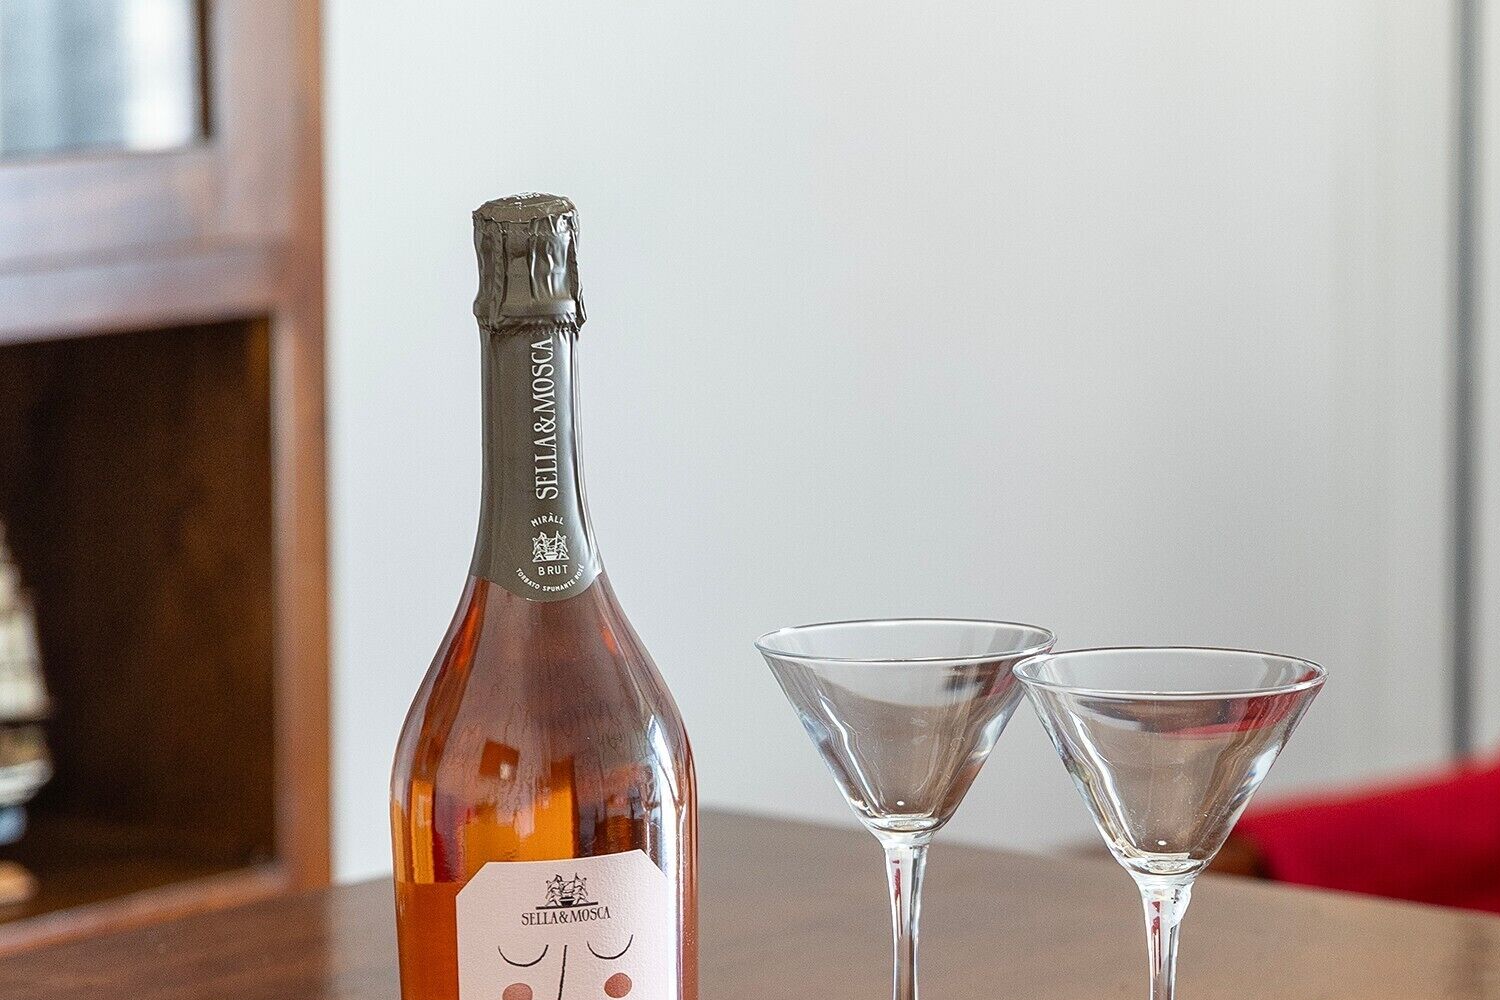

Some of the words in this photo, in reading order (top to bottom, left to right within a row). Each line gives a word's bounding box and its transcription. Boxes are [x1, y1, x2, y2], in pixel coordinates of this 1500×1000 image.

[531, 336, 559, 500] SELLA&MOSCA
[530, 512, 565, 528] MIRÀLL
[515, 567, 541, 590] TORBATO
[541, 580, 576, 592] SPUMANTE
[538, 564, 569, 576] BRUT
[521, 906, 611, 926] SELLA&MOSCA
